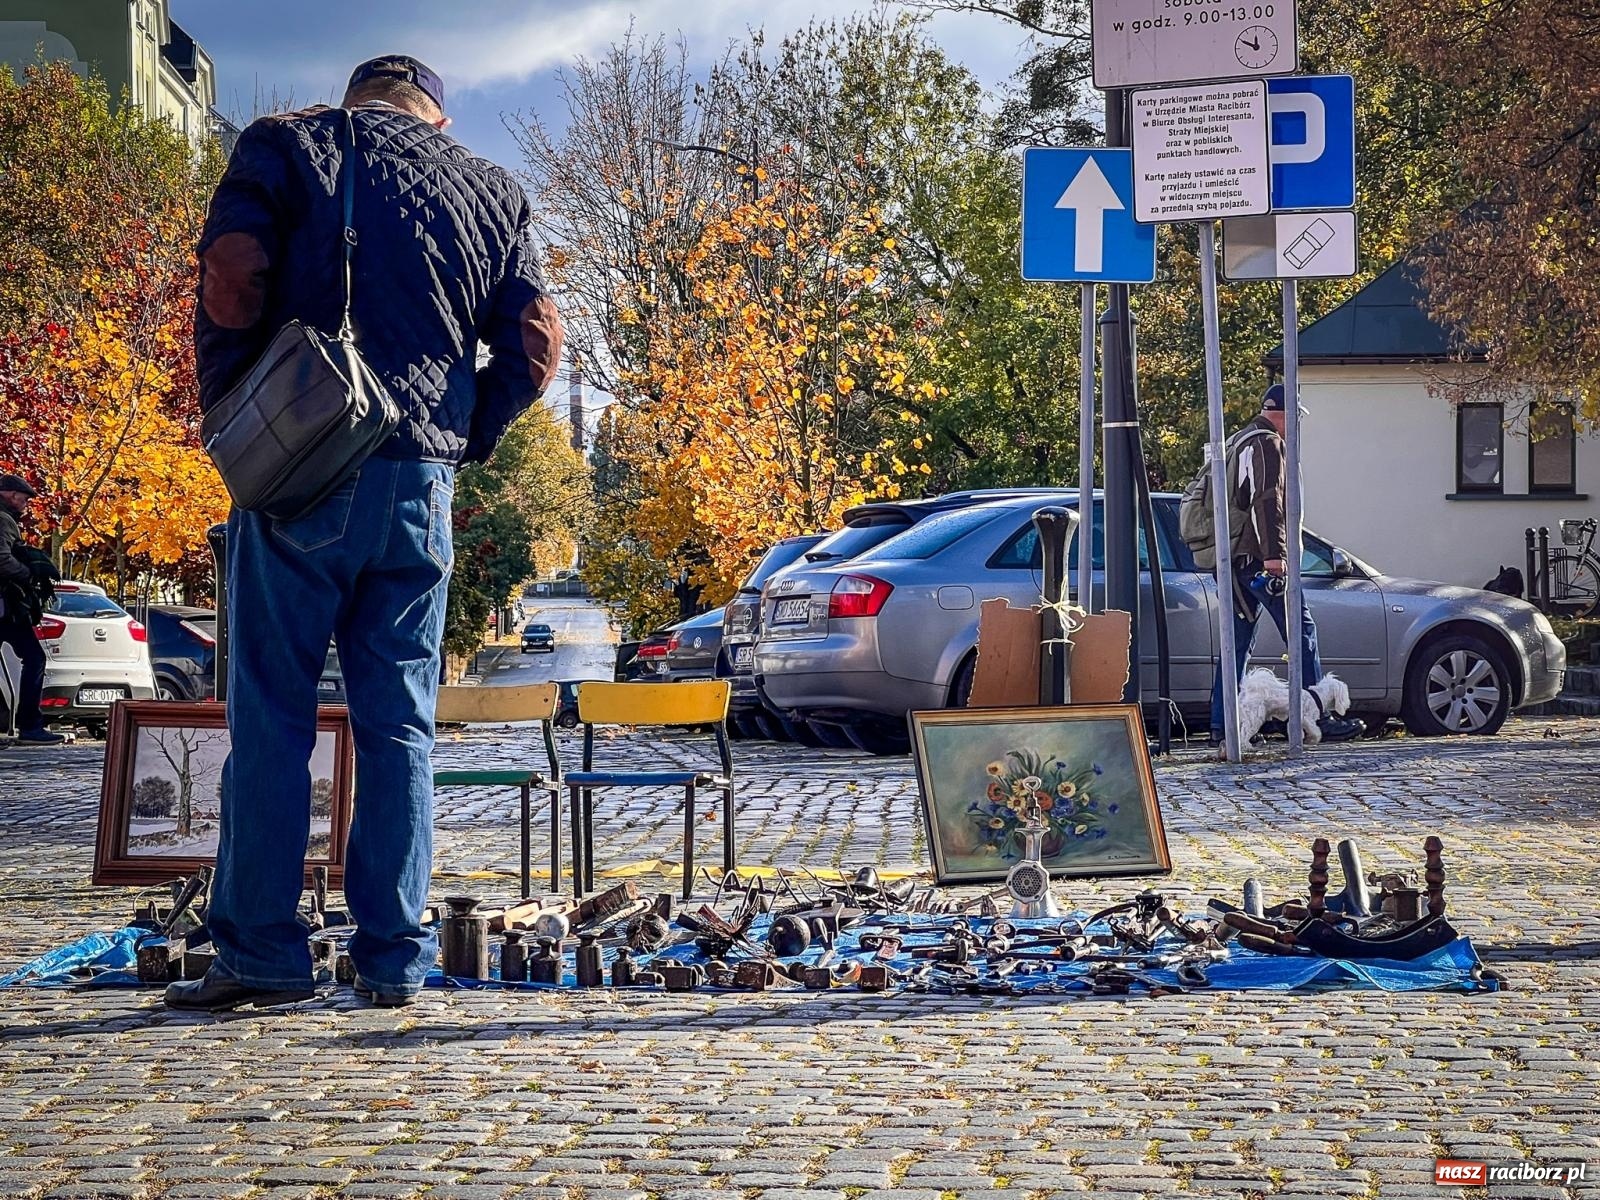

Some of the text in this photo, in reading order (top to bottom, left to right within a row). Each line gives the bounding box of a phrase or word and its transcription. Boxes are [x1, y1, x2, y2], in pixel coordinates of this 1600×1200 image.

[1113, 5, 1274, 33] w godz. 9.00-13.00
[1137, 89, 1259, 107] Karty parkingowe można pobrać
[1155, 106, 1186, 117] Urzędzie
[1189, 103, 1215, 113] Miasta
[1218, 101, 1251, 111] Racibórz
[1151, 117, 1175, 127] Biurze
[1178, 115, 1206, 125] Obsługi
[1208, 112, 1255, 123] Interesanta,
[1168, 124, 1229, 137] Straży Miejskiej
[1193, 135, 1233, 147] pobliskich
[1156, 145, 1242, 160] punktach handlowych.
[1144, 173, 1165, 182] Kartę
[1168, 171, 1192, 180] należy
[1194, 168, 1224, 178] ustawić
[1162, 181, 1197, 192] przyjazdu
[1205, 178, 1240, 188] umieścić
[1169, 191, 1210, 201] widocznym
[1212, 189, 1242, 199] miejscu
[1162, 203, 1194, 214] przednią
[1196, 201, 1218, 211] szybą
[1220, 200, 1252, 210] pojazdu.
